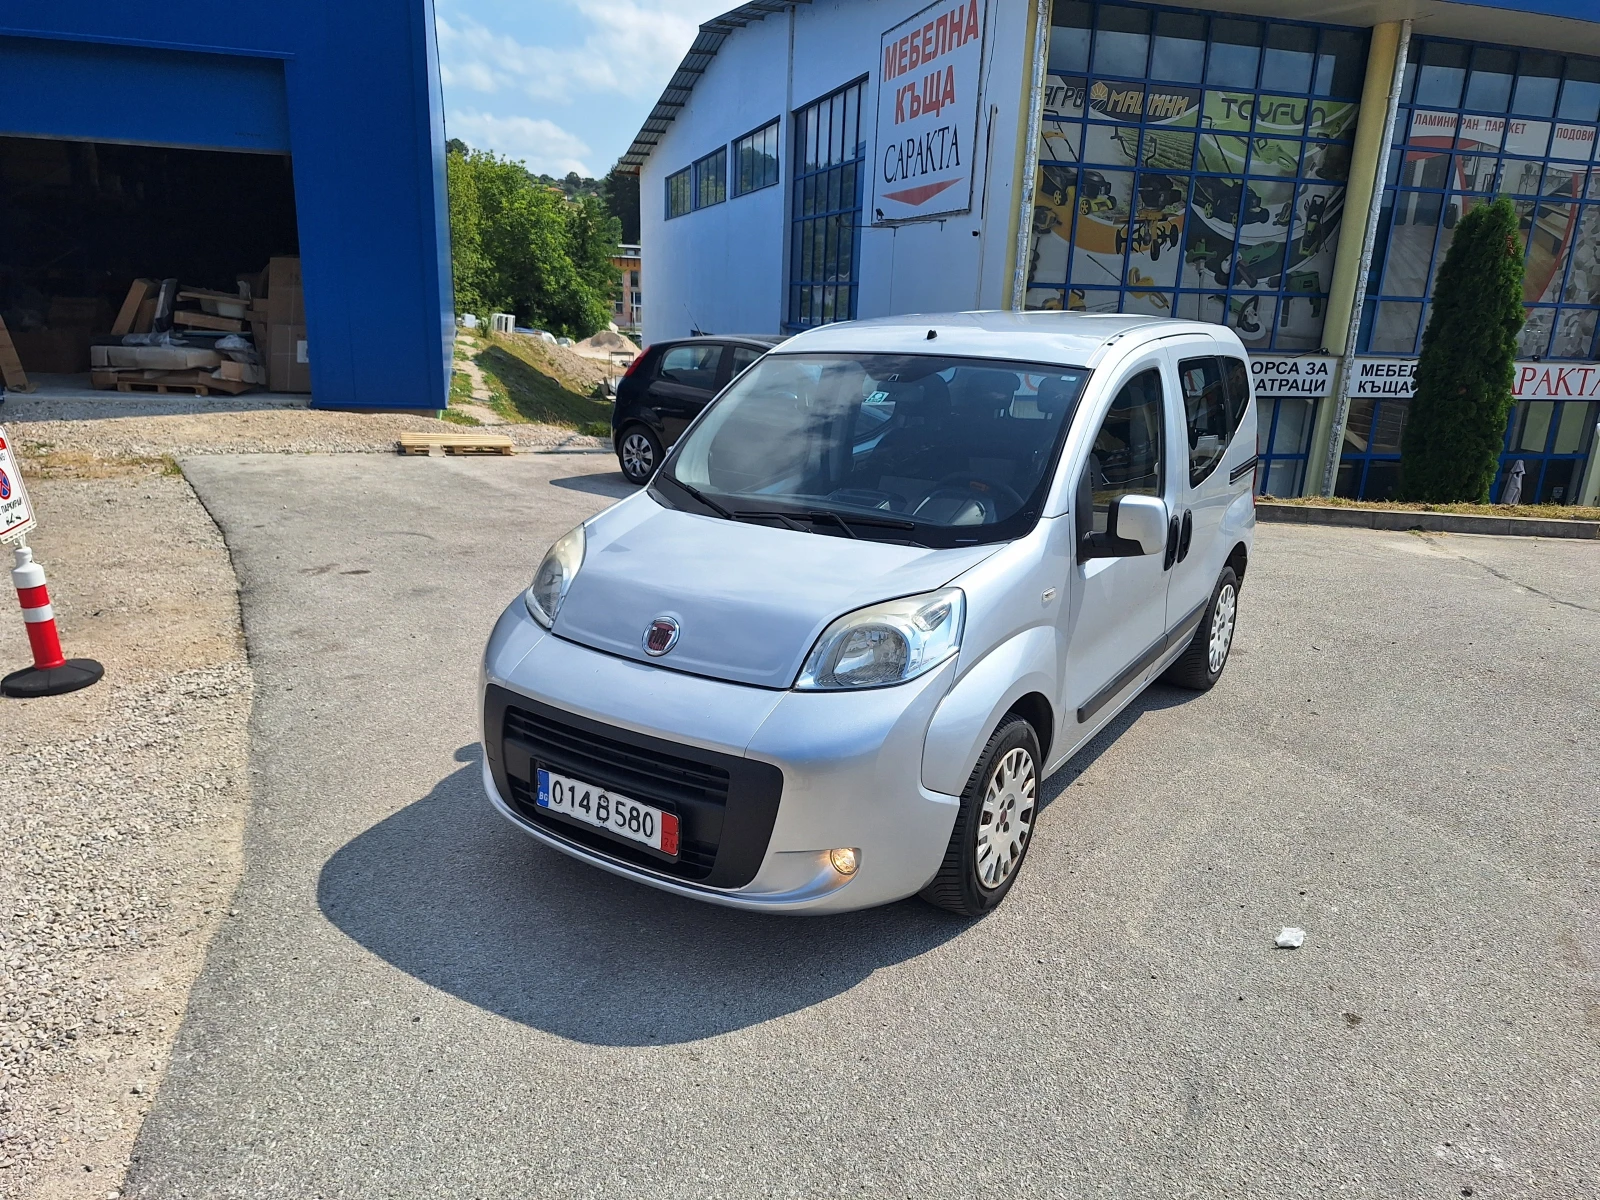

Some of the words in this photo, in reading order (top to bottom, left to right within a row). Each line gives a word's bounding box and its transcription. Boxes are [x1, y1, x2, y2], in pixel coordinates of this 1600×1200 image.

[884, 0, 979, 83] МЕБЕЛНА
[894, 64, 956, 125] КЪЩА
[1414, 113, 1479, 131] ЛАМИНИРАН
[1484, 119, 1527, 135] ПАРКЕТ
[1556, 127, 1595, 142] ПОДОВИ
[883, 123, 961, 184] САРАКТА
[1251, 361, 1300, 375] ОРСА
[1305, 362, 1328, 375] ЗА
[1360, 363, 1419, 377] МЕБЕЛ
[1253, 378, 1326, 394] АТРАЦИ
[1357, 380, 1410, 396] КЪЩА
[1511, 366, 1600, 396] РАКТ
[538, 791, 549, 802] BG
